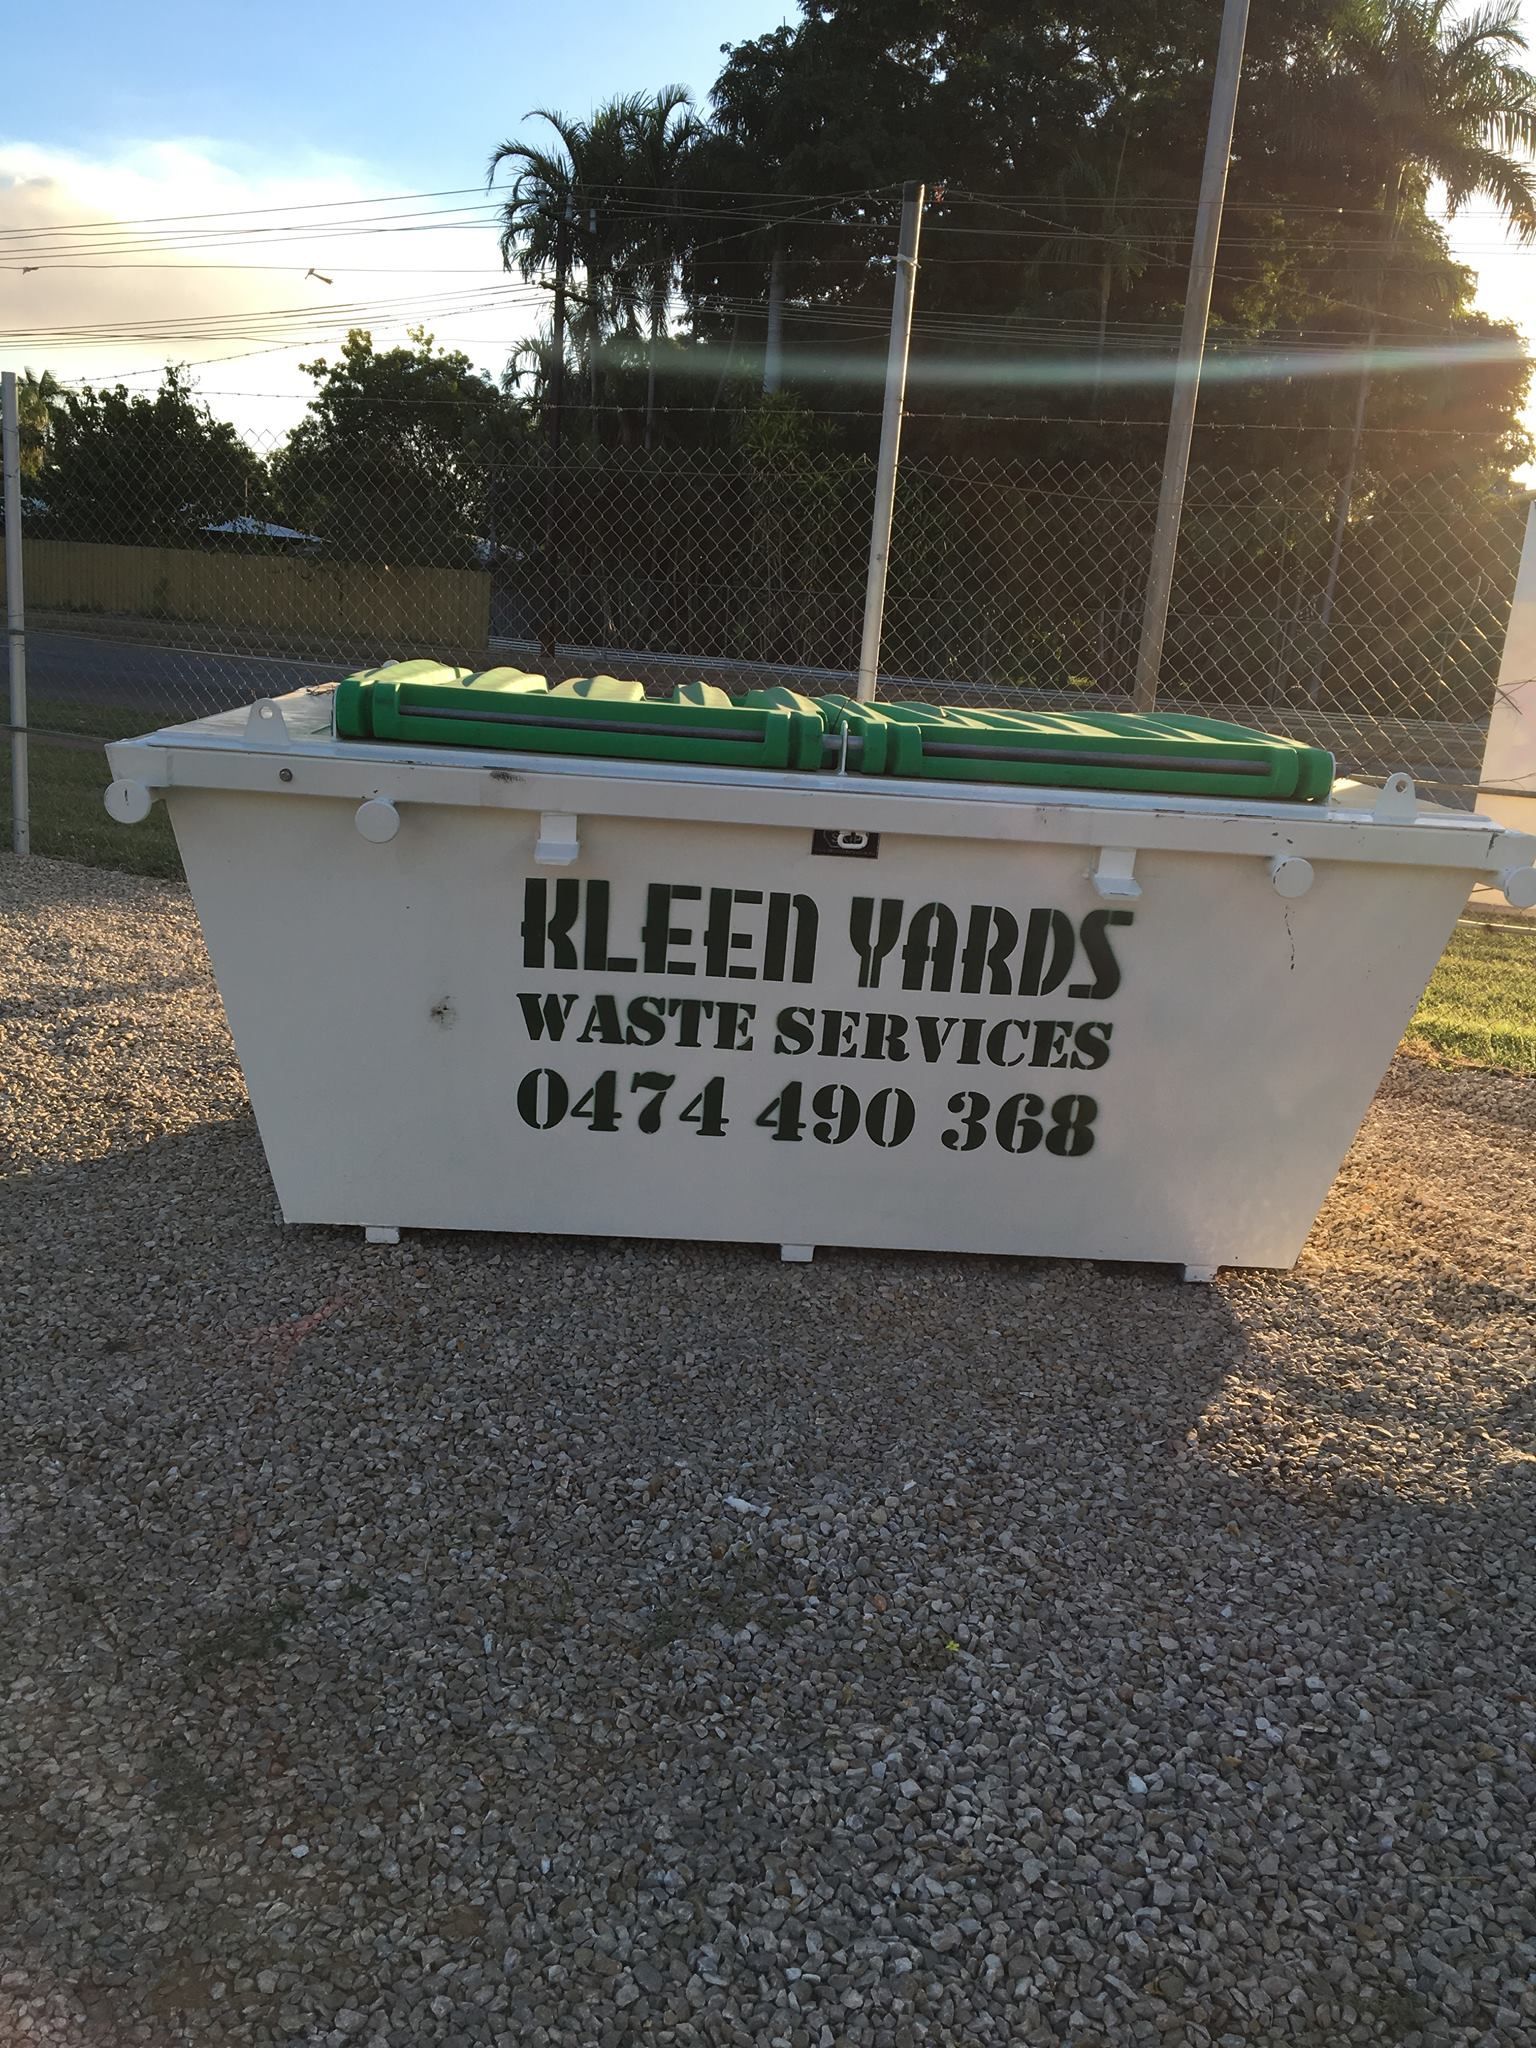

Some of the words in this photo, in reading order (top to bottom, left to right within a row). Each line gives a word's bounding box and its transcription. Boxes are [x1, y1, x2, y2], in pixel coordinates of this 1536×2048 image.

[521, 877, 819, 984] KLEEN
[849, 895, 1134, 1001] YARDS
[515, 992, 757, 1052] WASTE
[774, 1006, 1114, 1071] SERVICES
[516, 1067, 729, 1137] 0474
[755, 1080, 916, 1148] 490
[940, 1090, 1099, 1158] 368
